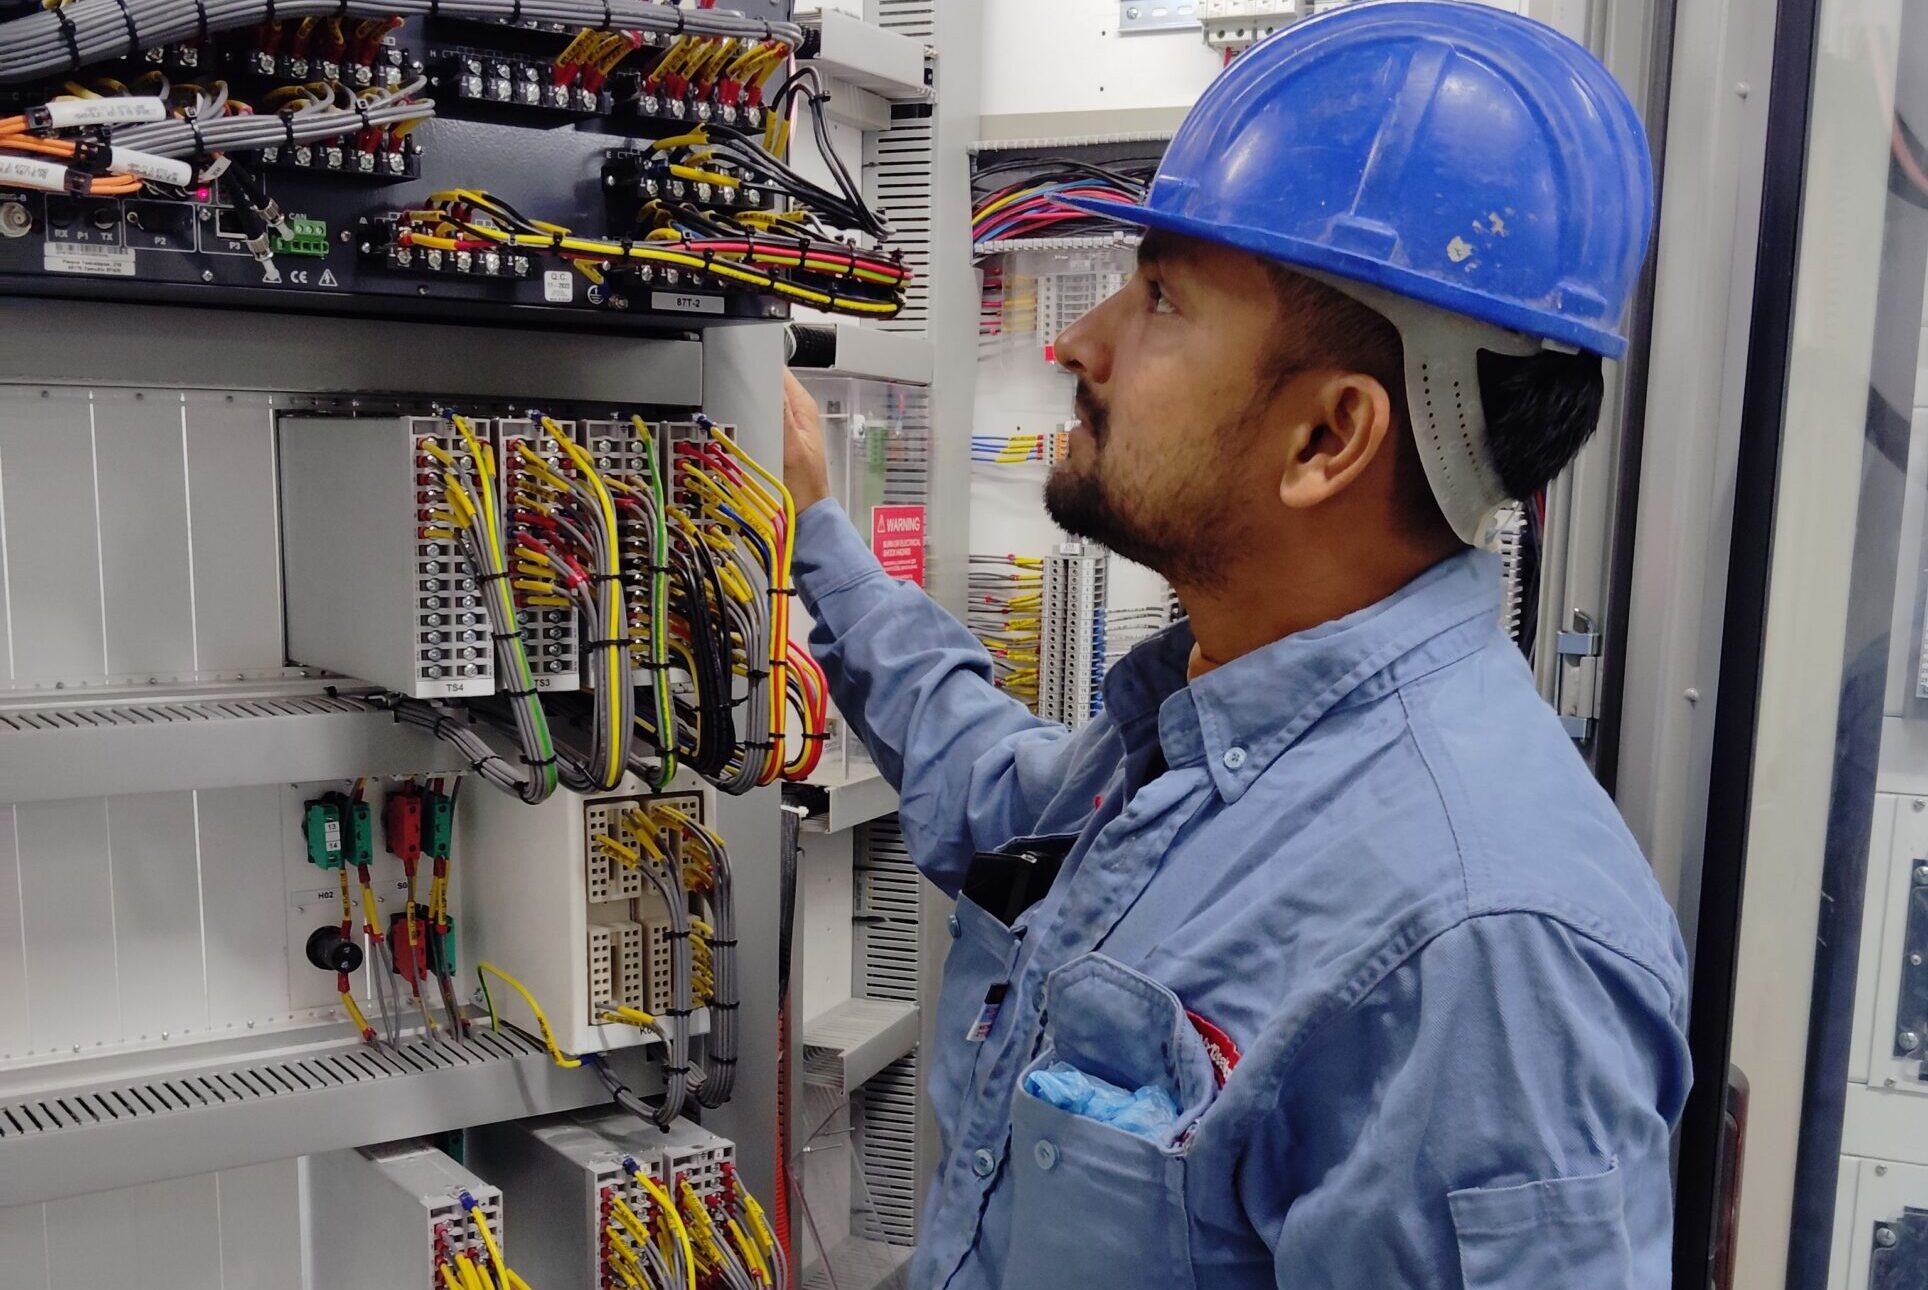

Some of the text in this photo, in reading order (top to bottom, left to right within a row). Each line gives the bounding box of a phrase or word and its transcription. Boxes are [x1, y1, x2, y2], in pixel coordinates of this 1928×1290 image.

[54, 229, 113, 241] RX P1 TX
[155, 236, 167, 245] P2
[229, 242, 241, 250] P3
[676, 297, 700, 308] 87T-2
[886, 516, 920, 532] WARNING
[445, 683, 464, 692] TS4
[534, 679, 550, 687] TS3
[318, 891, 334, 899] H02
